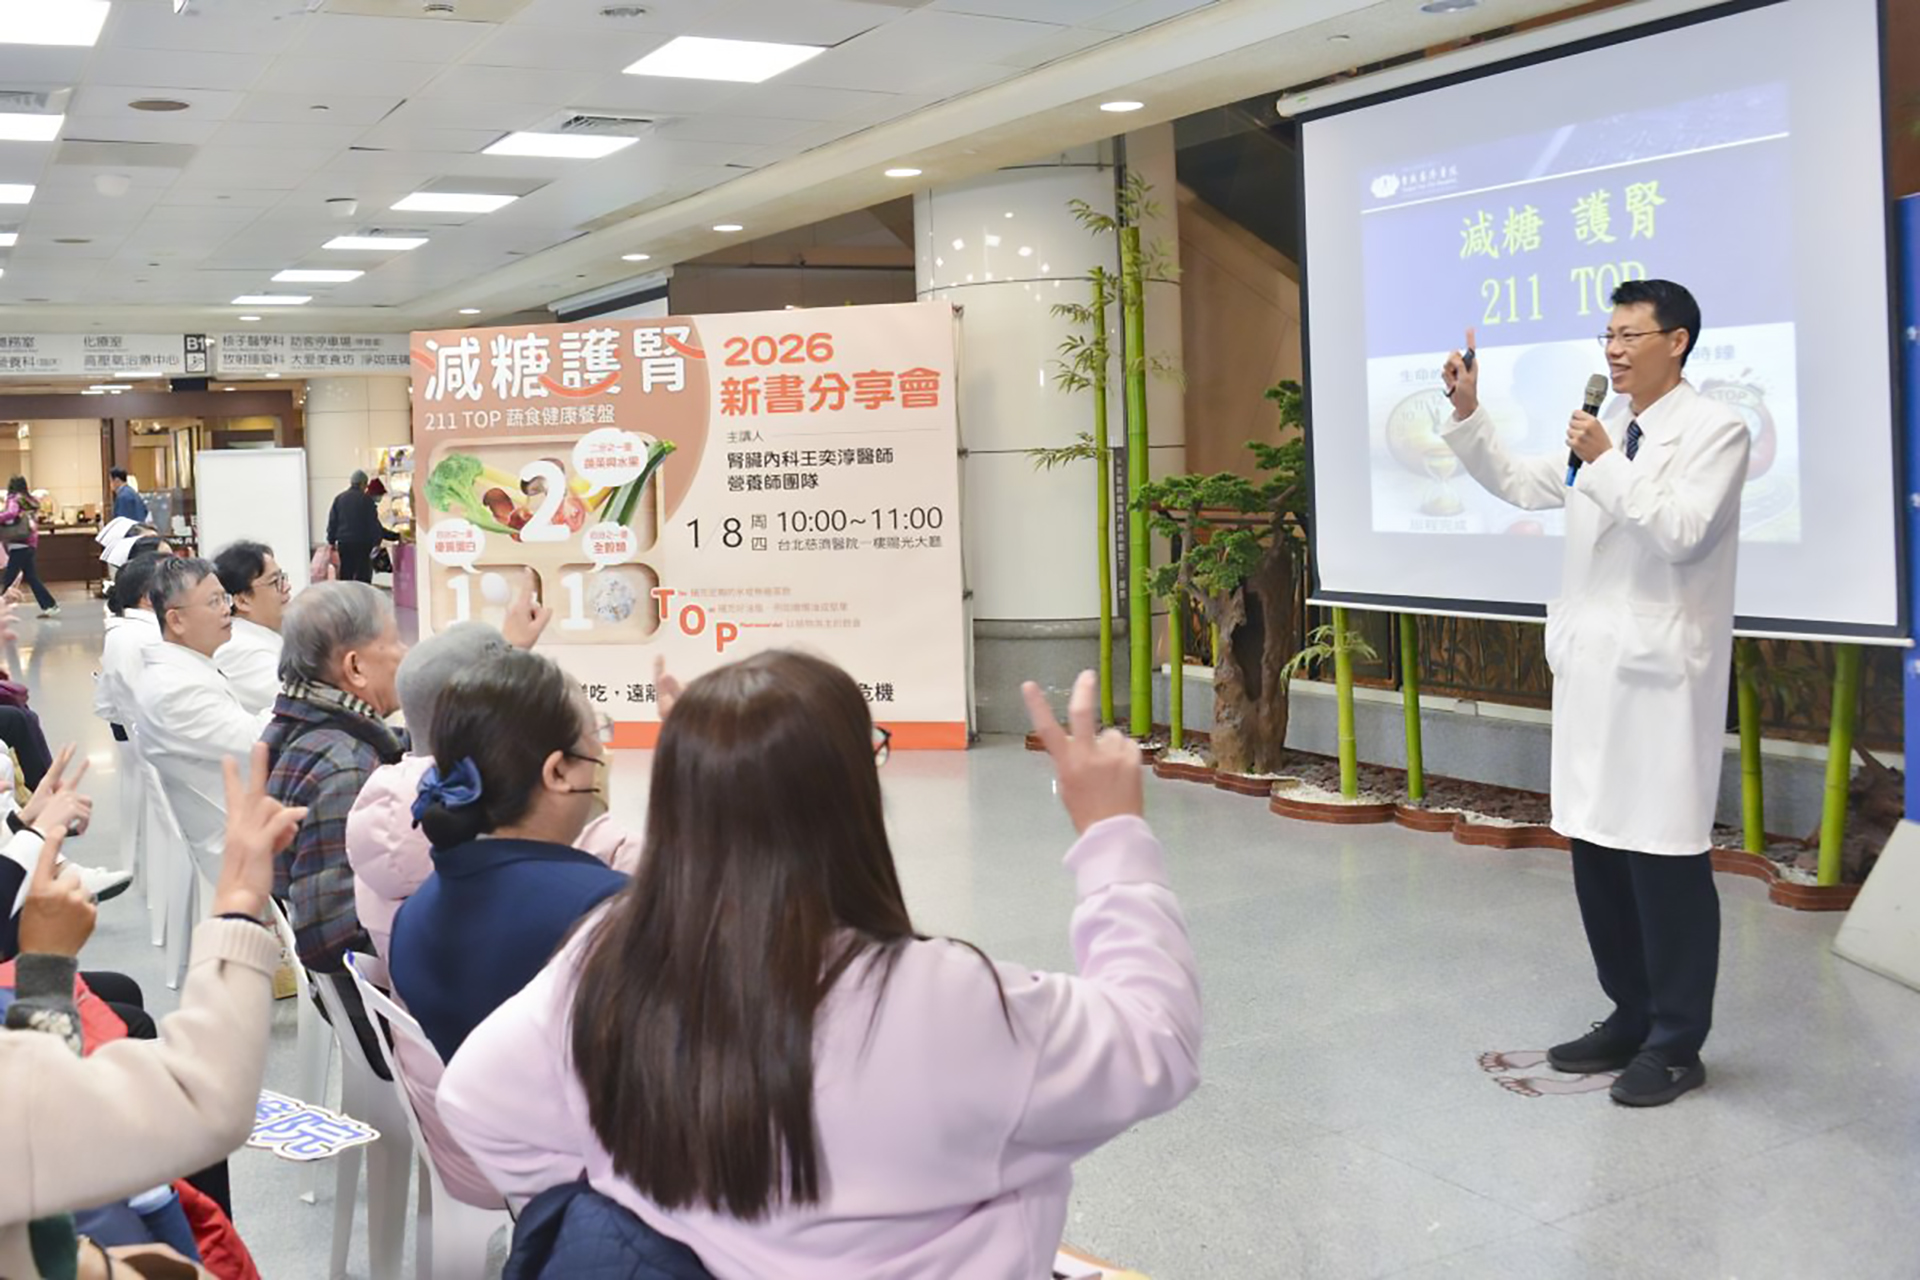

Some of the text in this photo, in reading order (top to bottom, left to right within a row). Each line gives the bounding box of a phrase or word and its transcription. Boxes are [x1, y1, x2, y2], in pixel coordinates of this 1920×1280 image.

[1459, 180, 1667, 260] 減糖 護腎
[1481, 273, 1543, 325] 211
[186, 336, 205, 351] B1
[424, 326, 690, 401] 減糖護腎
[723, 332, 834, 367] 2026
[720, 367, 941, 416] 新書分享會
[425, 404, 615, 430] 211 TOP 蔬食健康餐盤
[727, 430, 764, 443] 主講人
[727, 447, 893, 468] 腎臟內科王奕淳醫師
[520, 459, 571, 542] 2
[727, 473, 819, 491] 營養師團隊
[560, 572, 594, 631] 1
